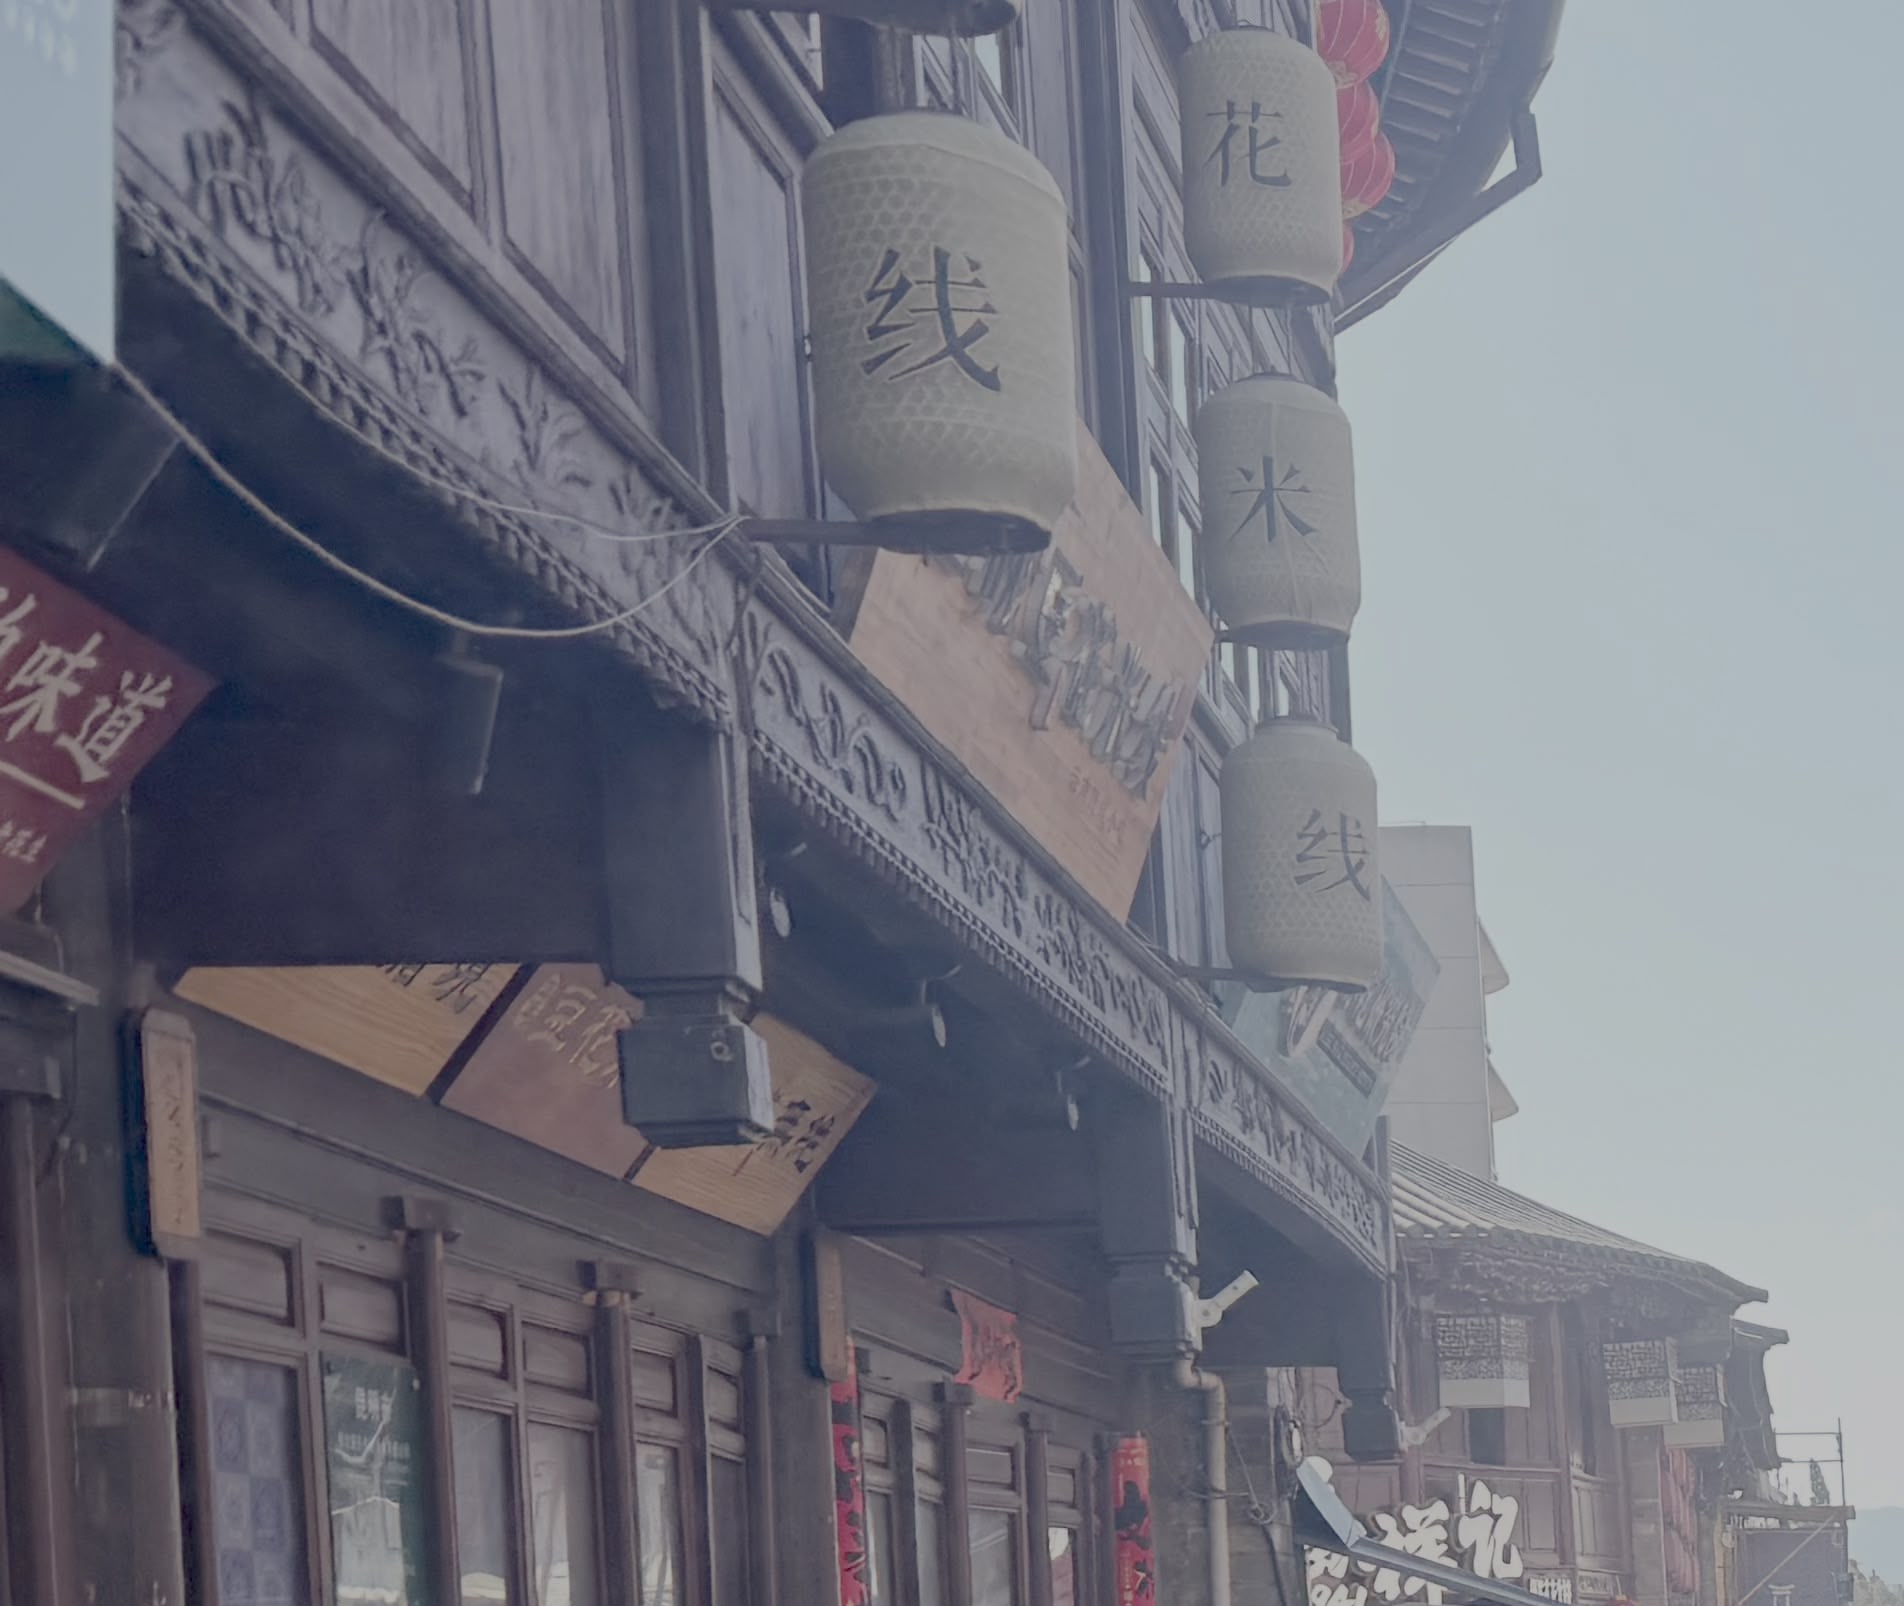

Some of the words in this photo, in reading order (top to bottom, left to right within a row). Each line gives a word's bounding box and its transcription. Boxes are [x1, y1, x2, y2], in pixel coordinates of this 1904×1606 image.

[1202, 99, 1293, 189] 花
[862, 246, 1002, 394] 线
[1229, 454, 1318, 542] 米
[1294, 807, 1373, 902] 线
